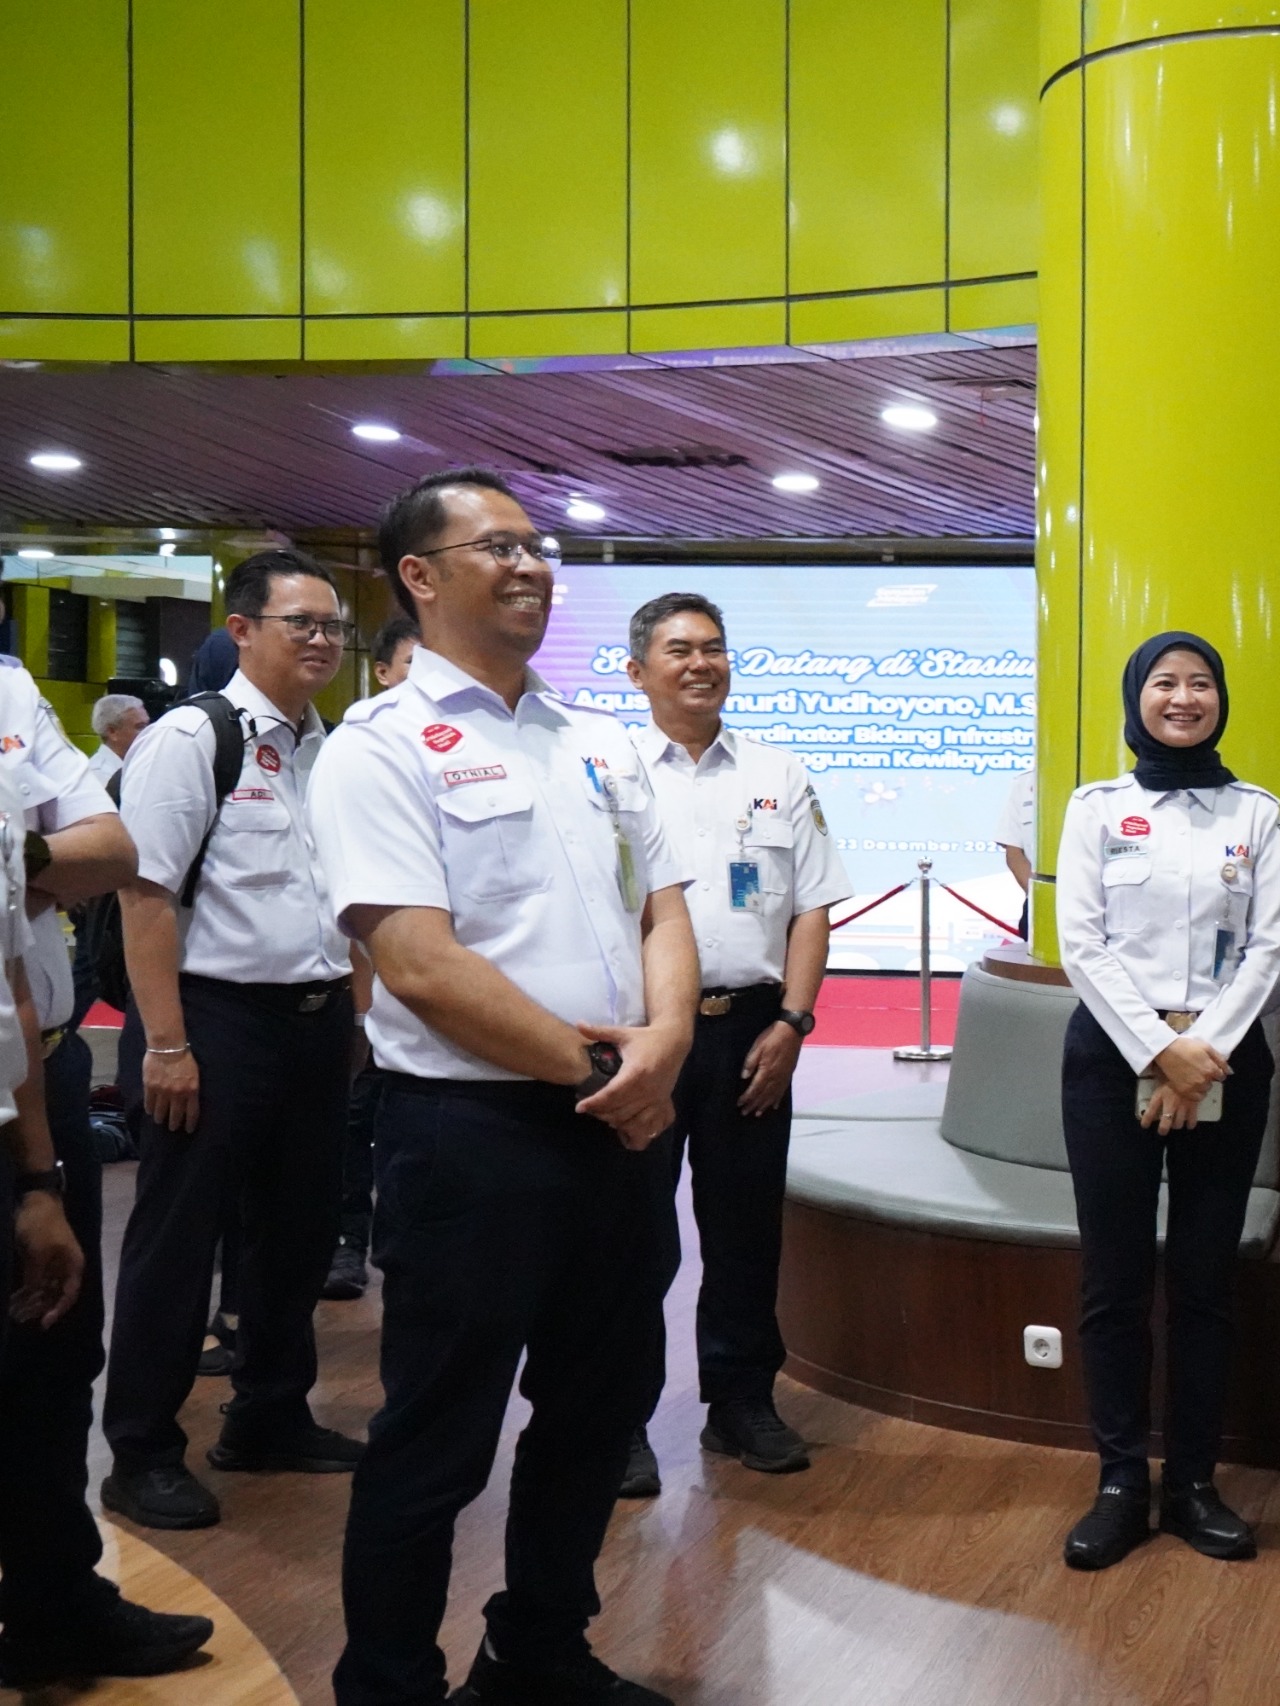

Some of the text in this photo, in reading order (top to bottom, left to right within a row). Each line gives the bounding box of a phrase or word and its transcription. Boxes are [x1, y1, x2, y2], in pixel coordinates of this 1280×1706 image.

[740, 649, 873, 683] Datang
[876, 650, 920, 676] di
[919, 649, 1035, 677] Stasiu
[575, 689, 1035, 720] Agus murti Yudhoyono, M.S
[727, 723, 1034, 748] ordinator Bidang Infrastr
[794, 749, 1035, 774] ngunan Kewilayaha
[836, 838, 858, 850] 23
[863, 839, 960, 852] Desember
